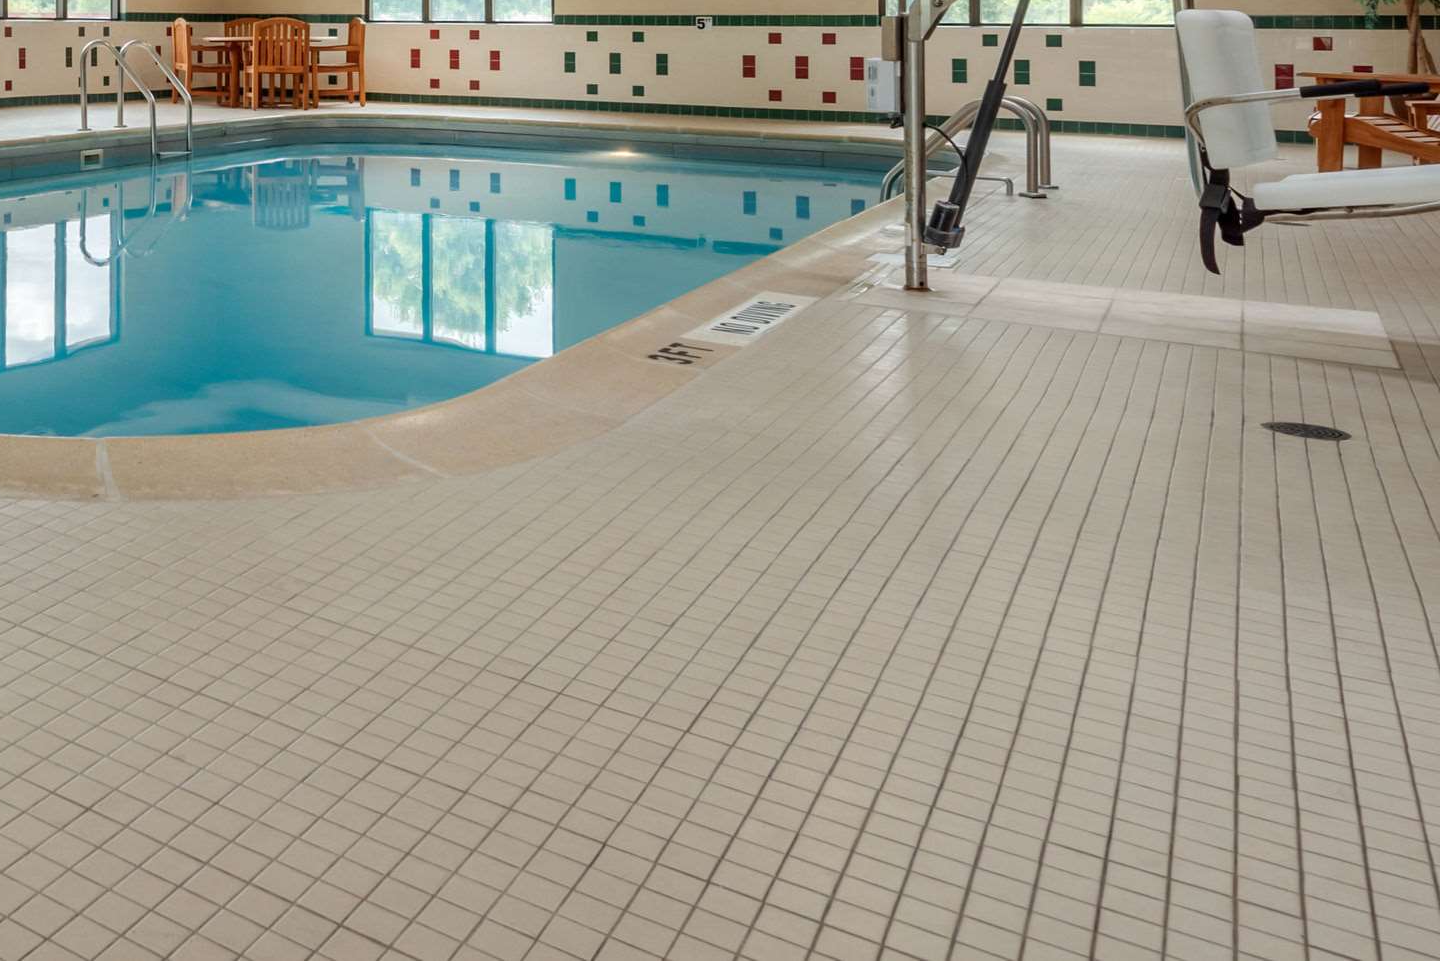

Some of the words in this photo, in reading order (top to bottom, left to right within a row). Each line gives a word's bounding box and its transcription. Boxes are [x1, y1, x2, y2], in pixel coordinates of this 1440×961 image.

[696, 18, 706, 30] 5
[729, 301, 797, 325] DIVING
[710, 322, 760, 336] NO
